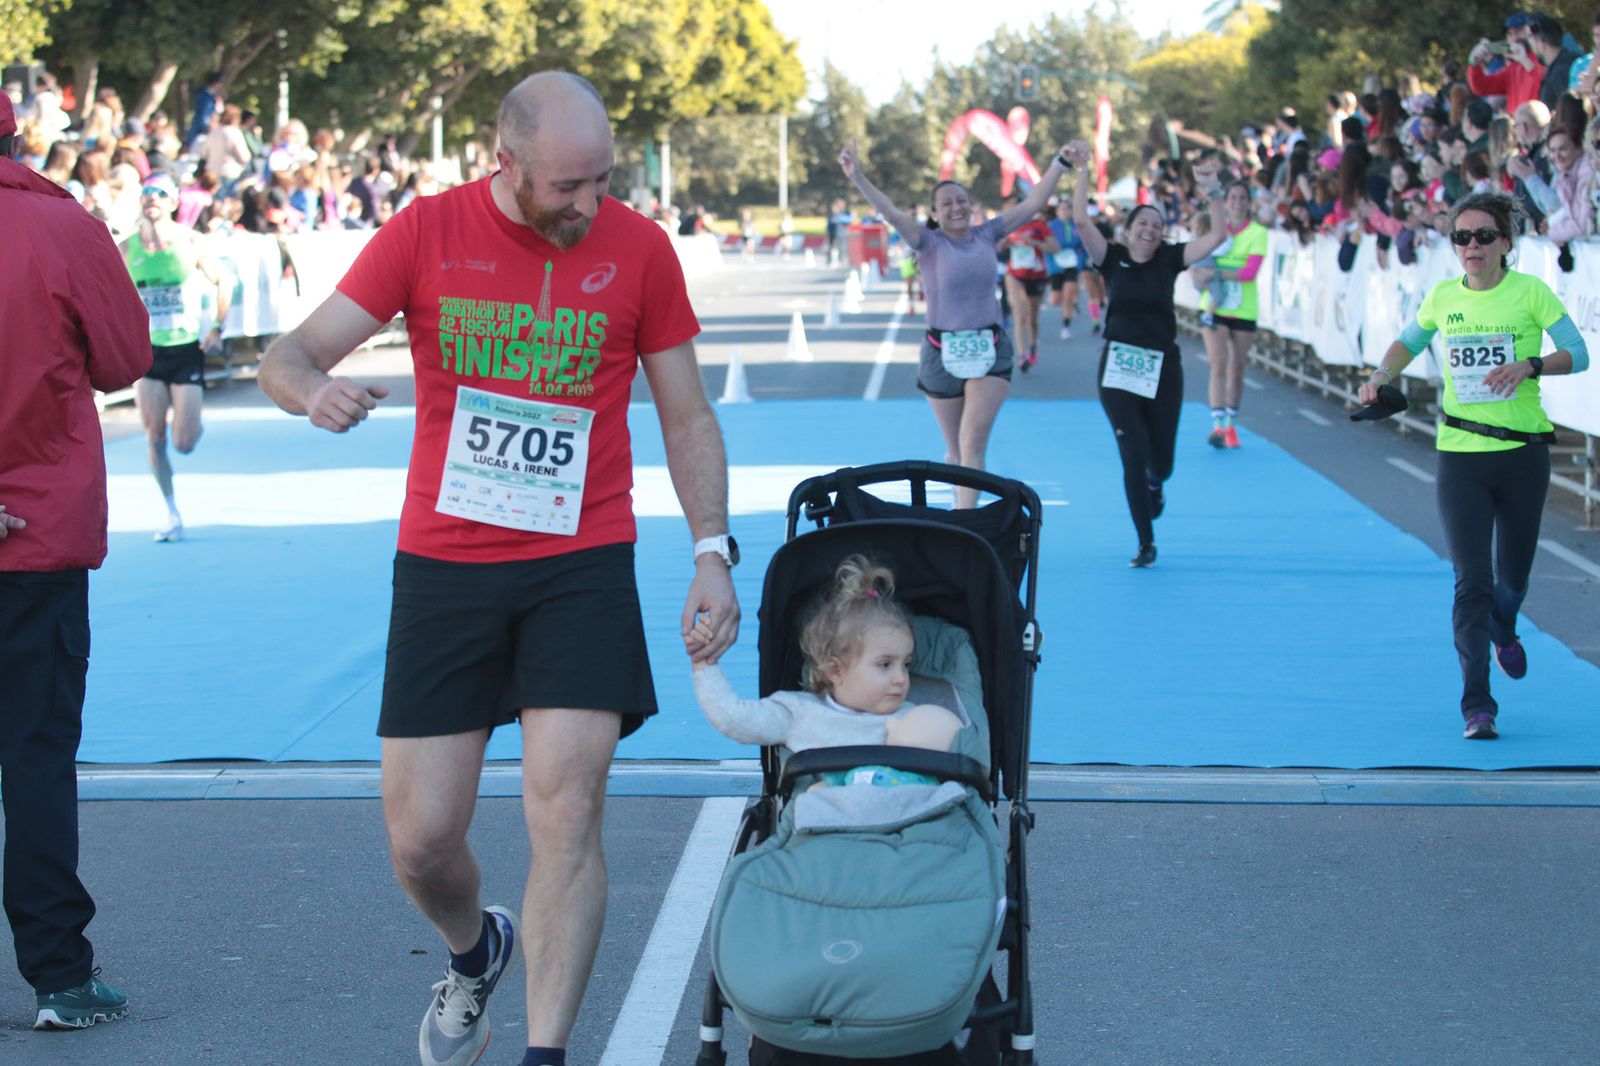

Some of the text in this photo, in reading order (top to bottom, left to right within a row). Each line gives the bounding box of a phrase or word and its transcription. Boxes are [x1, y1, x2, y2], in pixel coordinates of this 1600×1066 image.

[511, 303, 609, 347] PARIS
[439, 332, 602, 384] FINISHER
[949, 339, 989, 354] 5539
[1450, 346, 1506, 368] 5825
[1114, 351, 1155, 373] 5493
[466, 416, 575, 466] 5705
[473, 453, 508, 469] LUCAS
[512, 462, 521, 471] &
[525, 464, 559, 477] IRENE
